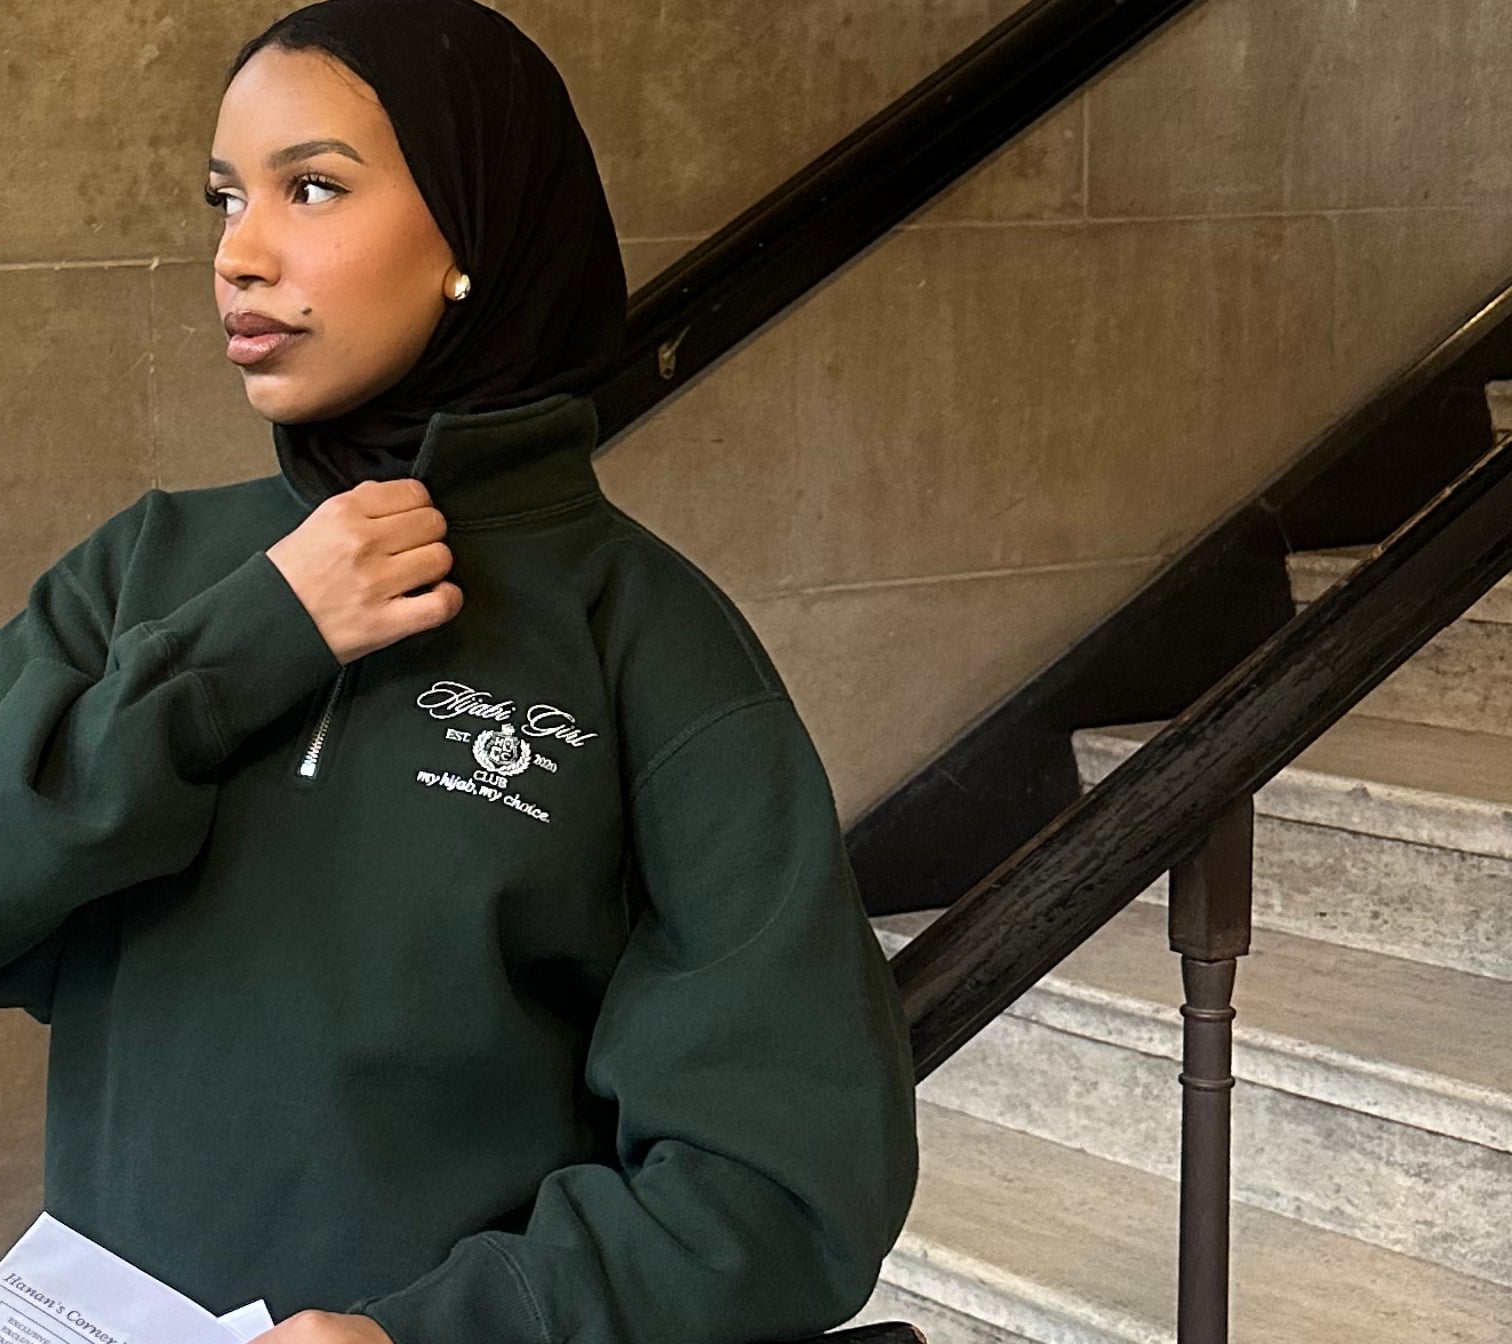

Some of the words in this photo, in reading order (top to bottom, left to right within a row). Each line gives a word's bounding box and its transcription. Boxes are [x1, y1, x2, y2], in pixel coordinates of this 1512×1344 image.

[416, 680, 517, 722] Hijabi
[521, 704, 599, 748] Girl
[416, 770, 441, 787] my
[478, 786, 503, 802] my
[473, 769, 508, 789] CLUB
[2, 1272, 66, 1315] Hanan's
